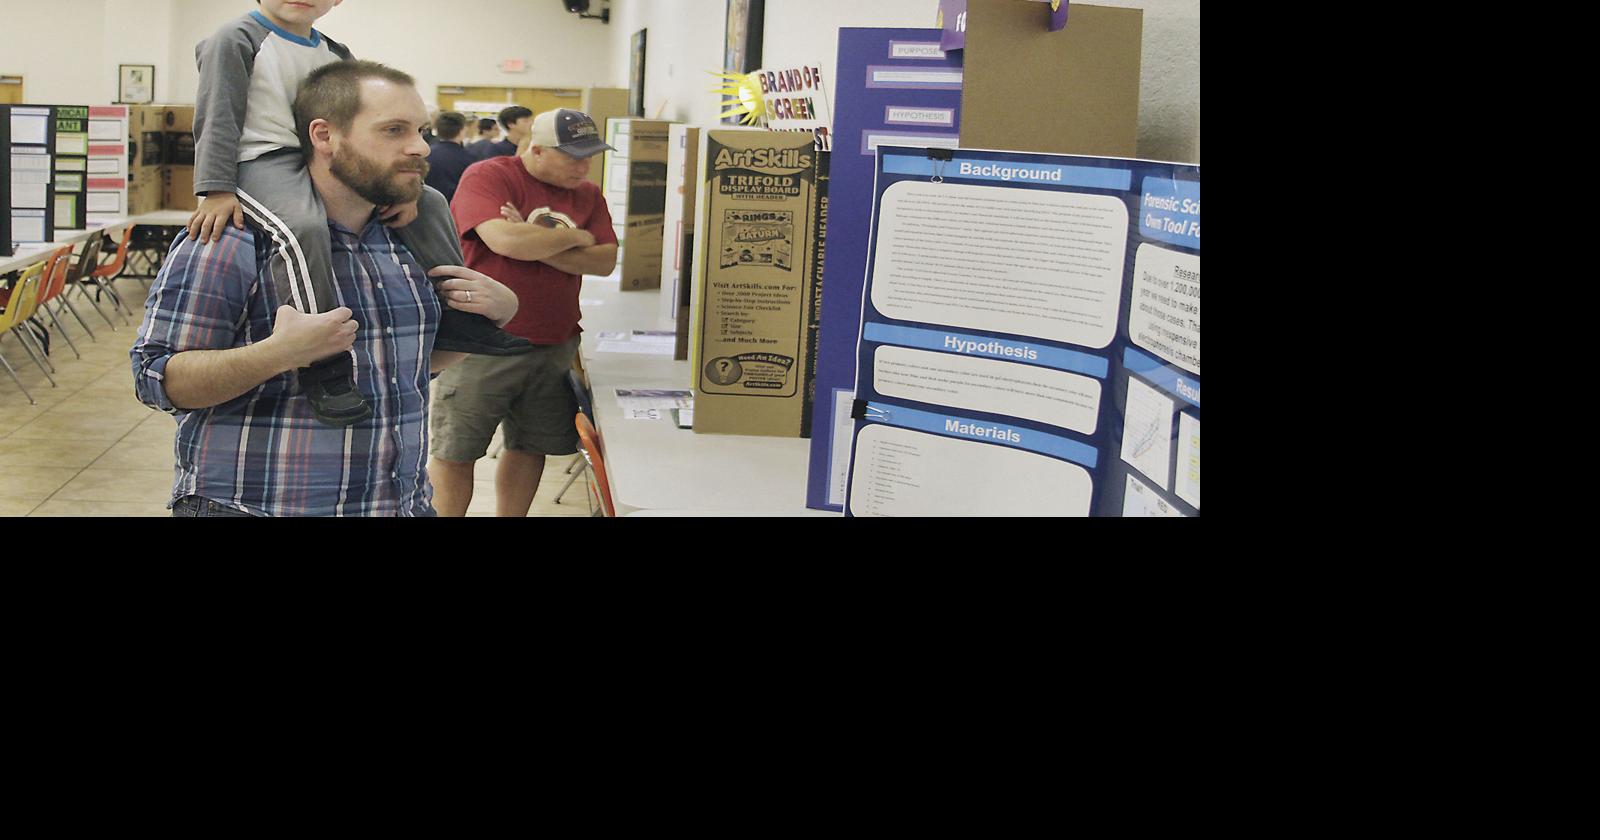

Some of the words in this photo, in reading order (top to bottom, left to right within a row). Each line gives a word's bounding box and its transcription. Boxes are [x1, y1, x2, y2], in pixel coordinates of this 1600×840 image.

[898, 47, 938, 55] PURPOSE
[759, 68, 803, 94] BRAND
[803, 66, 820, 91] OF
[766, 97, 816, 120] SCREEN
[892, 111, 945, 120] HYPOTHESIS
[715, 148, 812, 169] ArtSkills
[959, 161, 1062, 181] Background
[721, 185, 762, 193] DISPLAY
[764, 186, 799, 194] BOARD
[727, 175, 793, 187] TRIFOLD
[1144, 193, 1179, 211] Forensic
[742, 213, 776, 222] RINGS
[818, 196, 829, 238] HEADER
[1163, 217, 1187, 235] Tool
[739, 229, 779, 239] SATURN
[814, 241, 826, 306] DETACHABLE
[731, 282, 780, 290] ArtSkills.com
[1178, 302, 1198, 315] make
[944, 335, 1038, 360] Hypothesis
[768, 356, 791, 365] Idea?
[945, 419, 1021, 444] Materials
